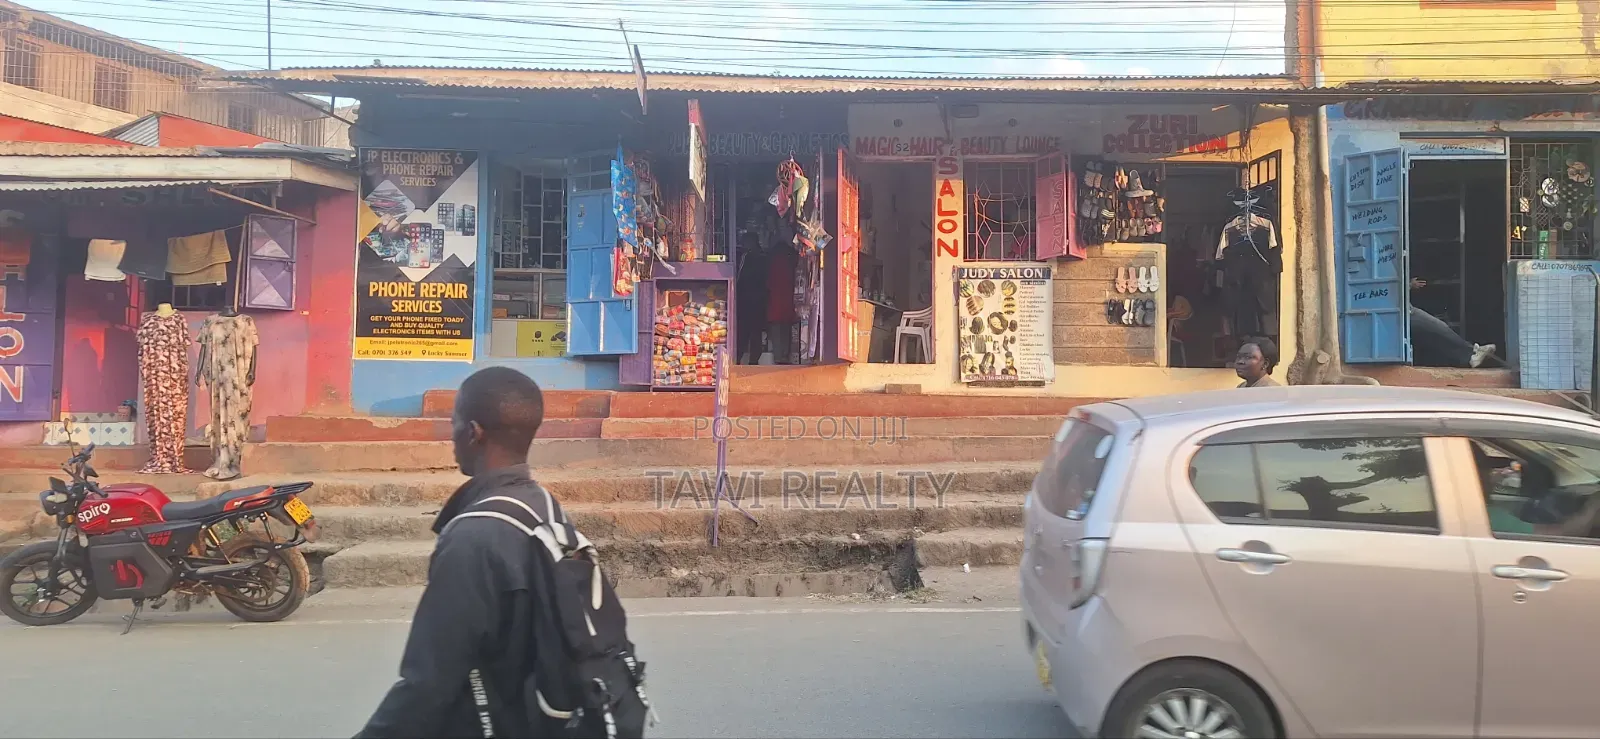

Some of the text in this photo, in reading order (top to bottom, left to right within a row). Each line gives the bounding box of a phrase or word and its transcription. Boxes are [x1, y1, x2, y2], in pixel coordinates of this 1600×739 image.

[1125, 114, 1198, 134] ZURI
[855, 136, 898, 156] MAGIC
[909, 136, 944, 156] HAIR
[961, 136, 1009, 156] BEAUTY
[1015, 136, 1062, 152] LOUNGE
[1102, 132, 1228, 153] COLLECTION
[382, 151, 452, 165] ELECTRONICS
[454, 153, 464, 165] &
[383, 164, 454, 177] PHONE REPAIR
[1376, 161, 1397, 177] ANGLE
[400, 176, 437, 187] SERVICES
[1350, 179, 1366, 191] DISK
[1376, 174, 1393, 187] LINE
[937, 156, 959, 258] SALON
[1352, 206, 1384, 221] WELDING
[1368, 214, 1389, 226] RODS
[962, 268, 1043, 279] JUDY SALON
[369, 281, 469, 299] PHONE REPAIR
[1354, 288, 1389, 301] TEE BARS
[391, 300, 443, 313] SERVICES
